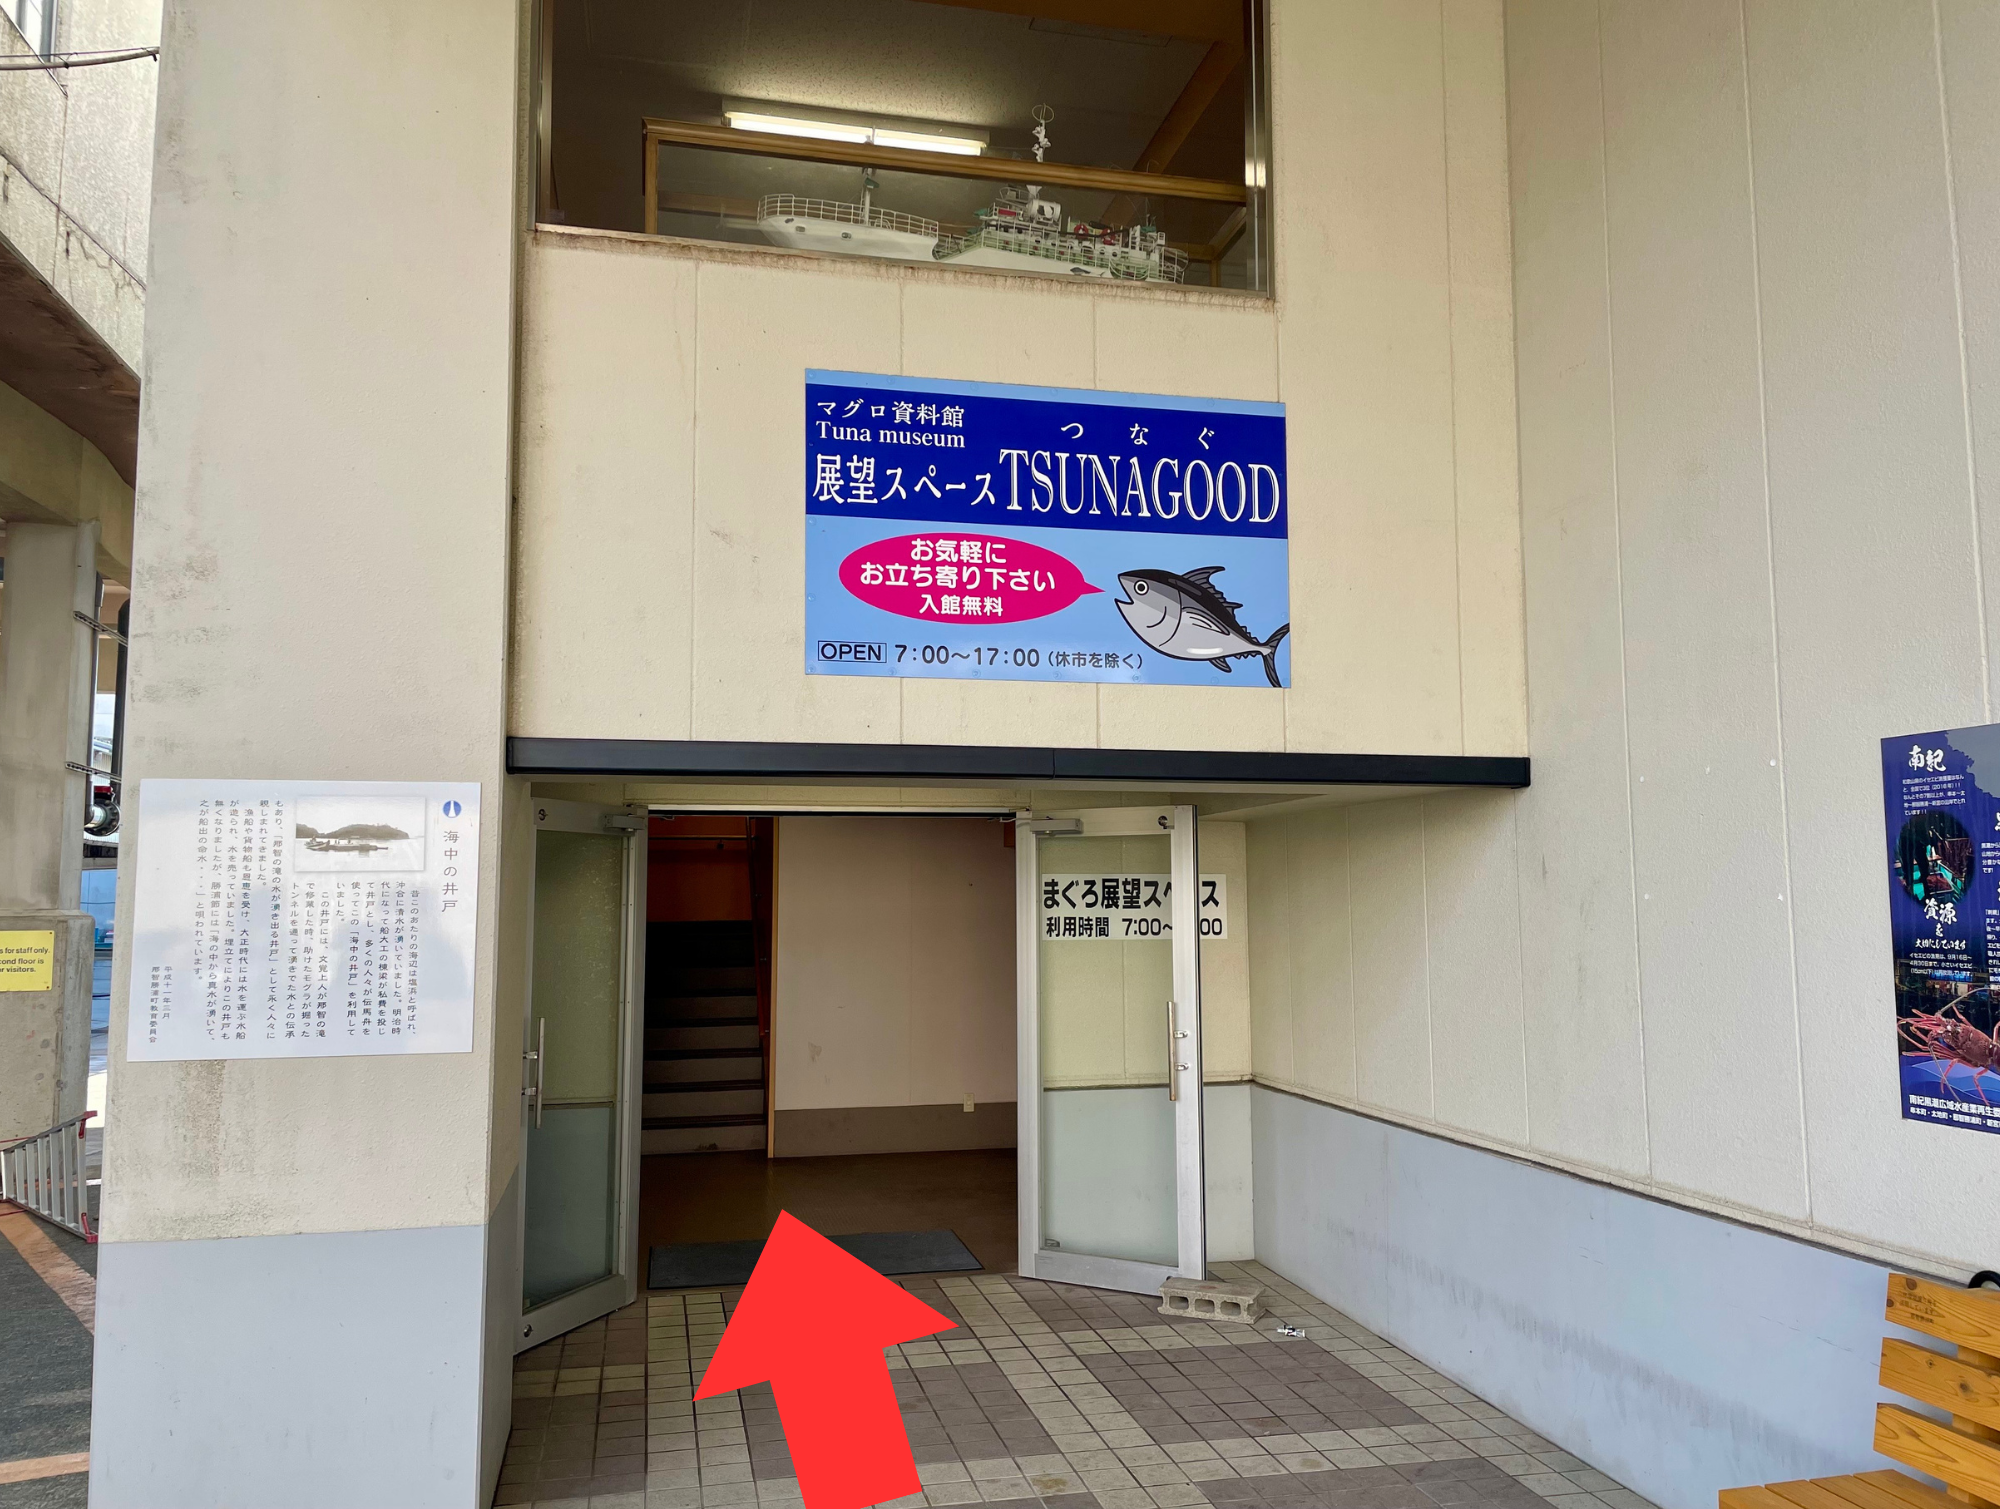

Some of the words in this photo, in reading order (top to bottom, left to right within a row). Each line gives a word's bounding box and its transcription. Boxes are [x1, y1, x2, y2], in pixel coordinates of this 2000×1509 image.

[817, 398, 965, 428] マグロ資料館
[815, 420, 872, 442] Tuna
[878, 428, 966, 448] museum
[812, 453, 996, 506] 展望スペース
[999, 449, 1280, 523] TSUNAGOOD
[911, 538, 1007, 563] お気軽に
[860, 562, 1056, 591] お立ち寄り下さい
[919, 594, 1004, 617] 入館無料
[820, 643, 882, 661] OPEN
[1908, 745, 1947, 772] 南紀
[441, 830, 460, 913] 海中の井戸
[1923, 898, 1957, 924] 資源
[1046, 916, 1110, 938] 利用時間
[1935, 923, 1943, 937] を
[33, 947, 50, 955] only.
